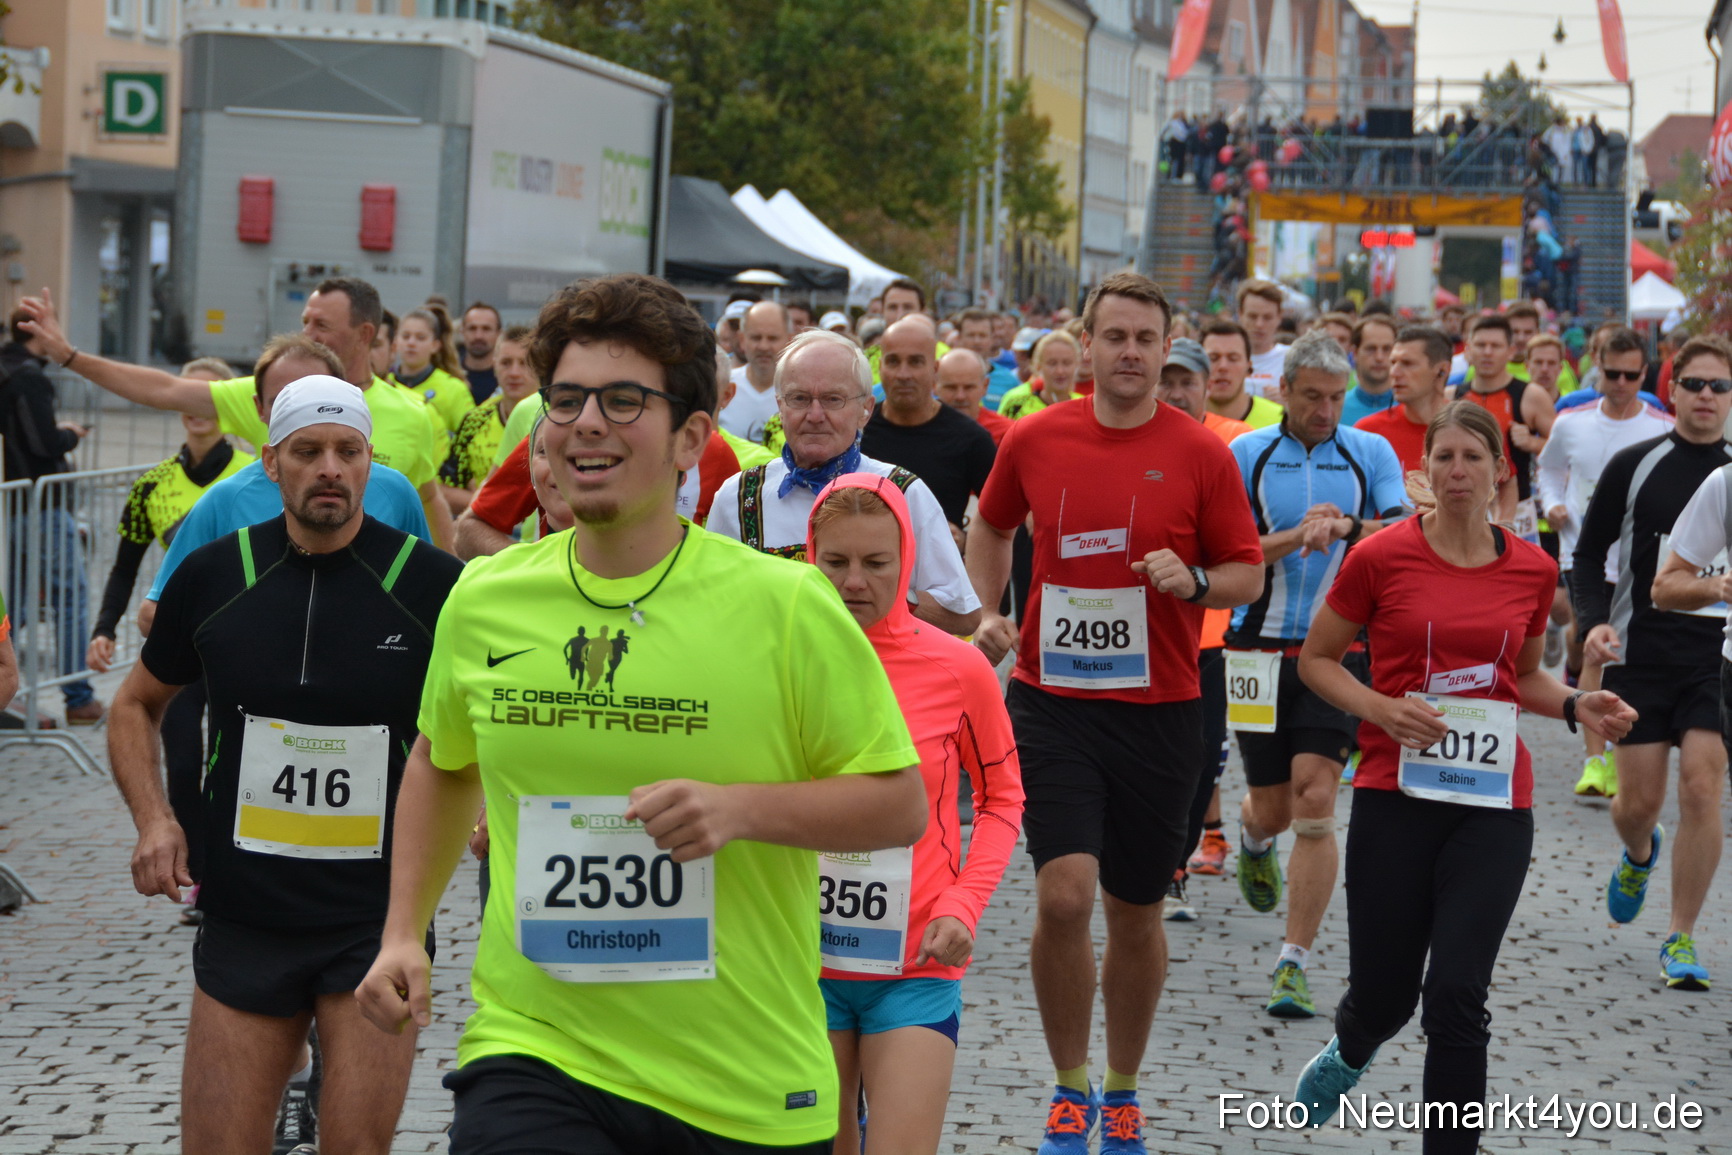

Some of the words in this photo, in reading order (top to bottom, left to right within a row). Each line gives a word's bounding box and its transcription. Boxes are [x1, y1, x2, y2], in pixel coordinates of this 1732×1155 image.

[112, 80, 159, 127] D
[1079, 537, 1108, 549] DEHN
[1077, 598, 1114, 607] BOCK
[1055, 618, 1130, 650] 2498
[1073, 660, 1113, 671] Markus
[1448, 673, 1477, 686] DEHN
[492, 688, 517, 701] SC
[1449, 705, 1487, 718] BOCK
[296, 737, 346, 750] BOCK
[1439, 771, 1476, 786] Sabine
[272, 764, 350, 808] 416
[245, 791, 251, 799] D
[544, 853, 683, 909] 2530
[819, 875, 888, 921] 356
[525, 901, 532, 911] C
[566, 929, 661, 952] Christoph
[821, 929, 859, 948] ktoria
